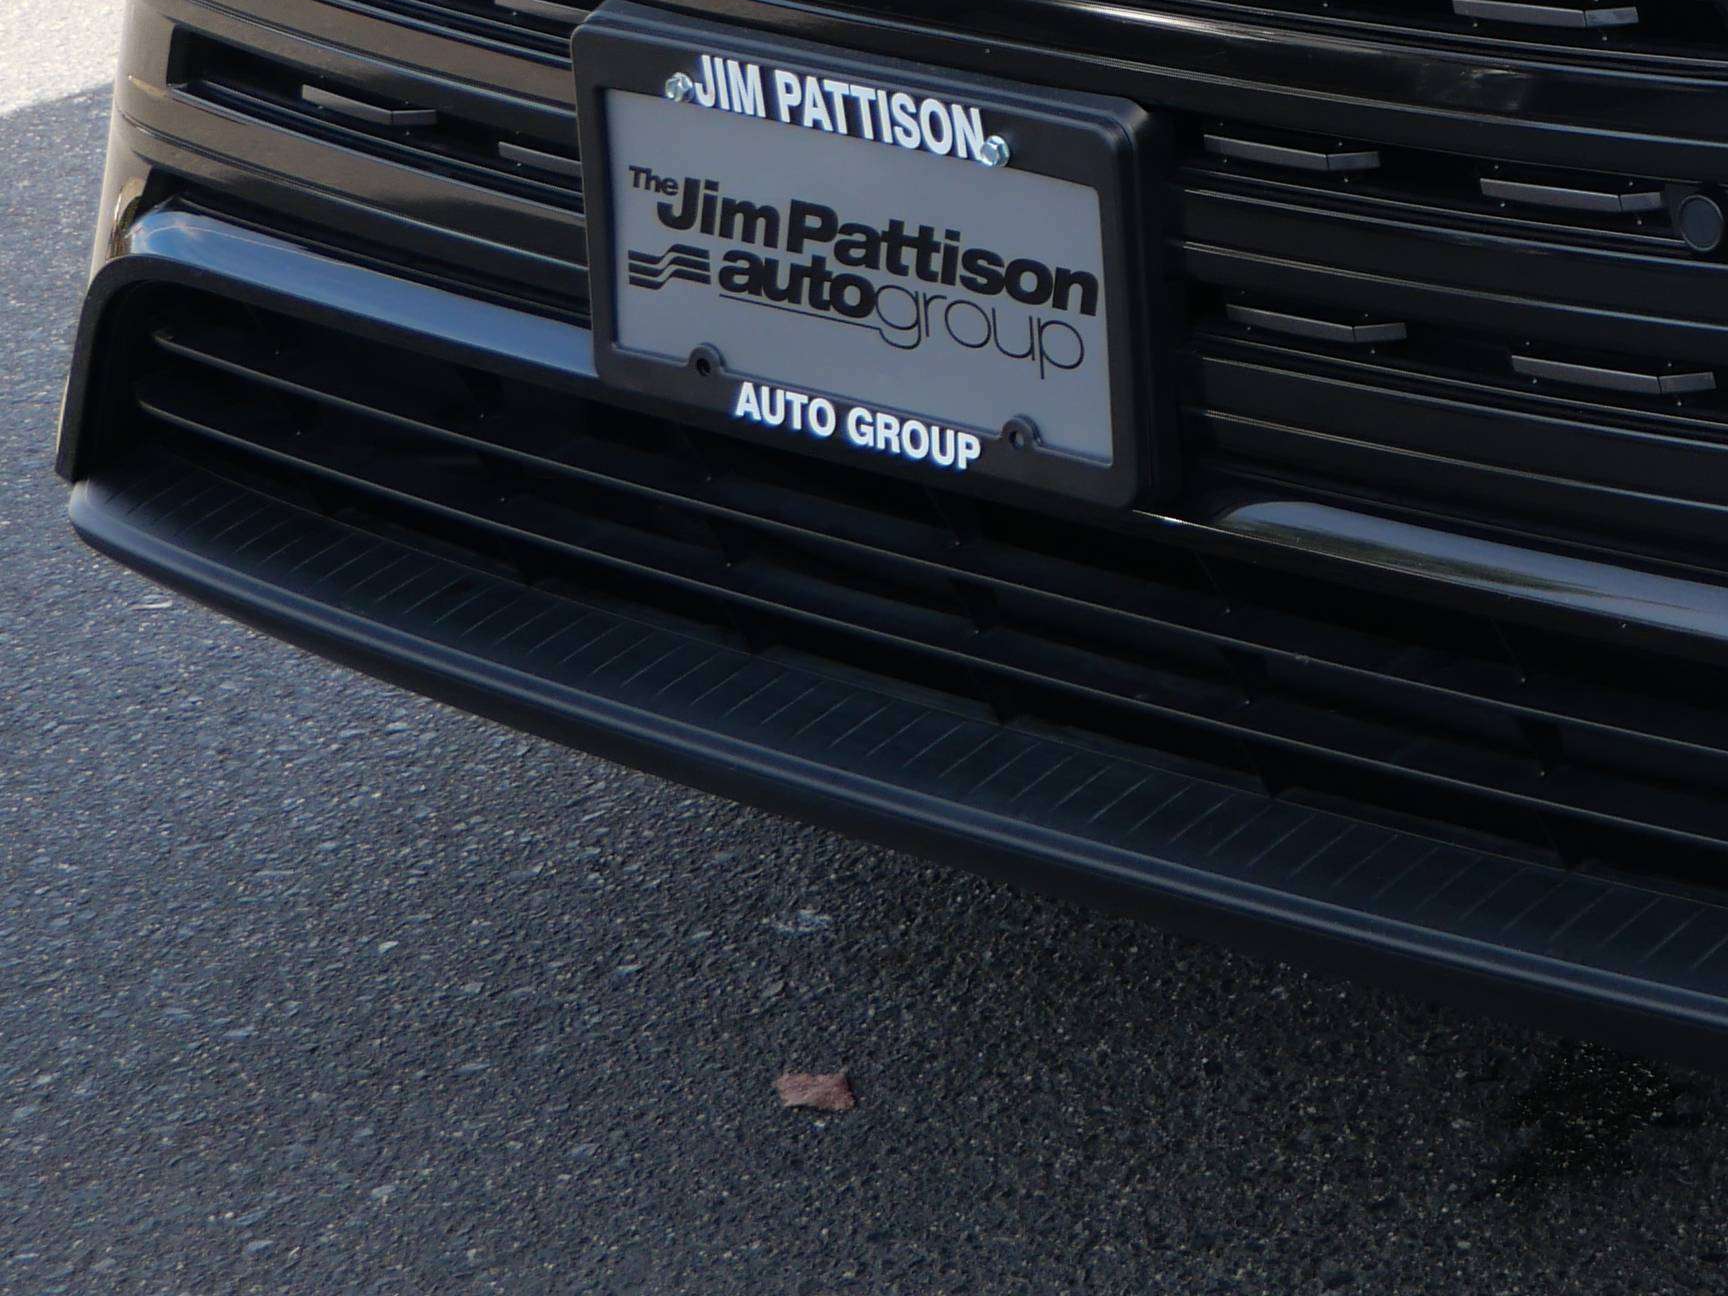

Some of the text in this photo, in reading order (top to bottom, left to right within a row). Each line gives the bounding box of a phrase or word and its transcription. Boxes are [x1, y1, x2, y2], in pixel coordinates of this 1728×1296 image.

[693, 54, 985, 161] JIM PATTISON
[629, 165, 1099, 316] The Jim Pattison
[735, 381, 981, 470] AUTO GROUP
